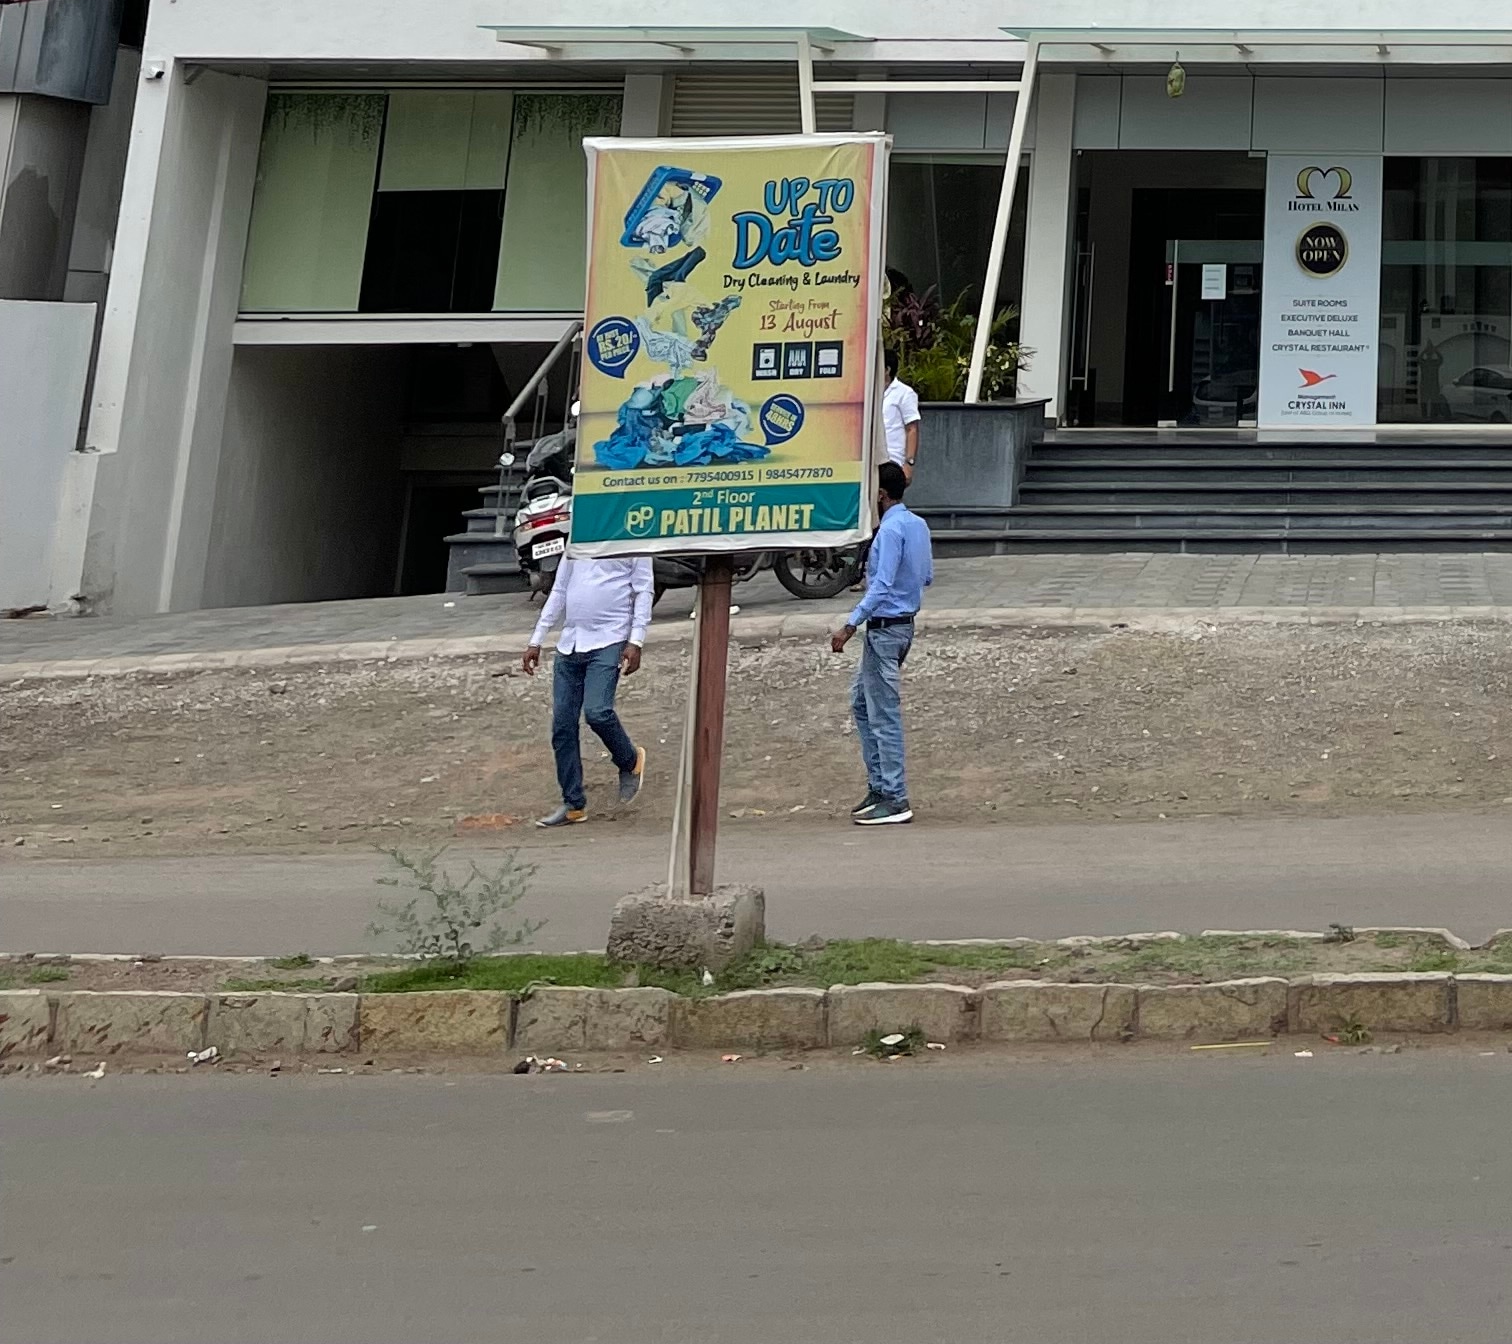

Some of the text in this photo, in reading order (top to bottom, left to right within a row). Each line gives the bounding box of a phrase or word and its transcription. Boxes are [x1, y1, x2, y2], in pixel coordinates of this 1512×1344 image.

[764, 177, 854, 216] UP TO
[732, 203, 842, 269] Date
[1306, 237, 1337, 248] NOW
[1302, 250, 1340, 261] OPEN
[723, 270, 860, 292] Dry Cleaning & Laundry
[769, 299, 829, 314] Starting From
[1292, 299, 1348, 307] SUITE ROOMS
[760, 309, 843, 338] 13 August
[1281, 314, 1358, 322] EXECUTIVE DELUXE
[1288, 329, 1350, 337] BANQUET HALL
[1272, 344, 1308, 352] CRYSTAL
[1288, 401, 1346, 410] CRYSTAL INN
[603, 474, 645, 488] Contact
[648, 474, 660, 485] us
[663, 473, 677, 484] on
[687, 470, 754, 483] 7795400915
[766, 467, 833, 480] 9845477870
[693, 489, 755, 505] 2nd Floor
[660, 508, 722, 536] PATIL
[729, 504, 815, 532] PLANET
